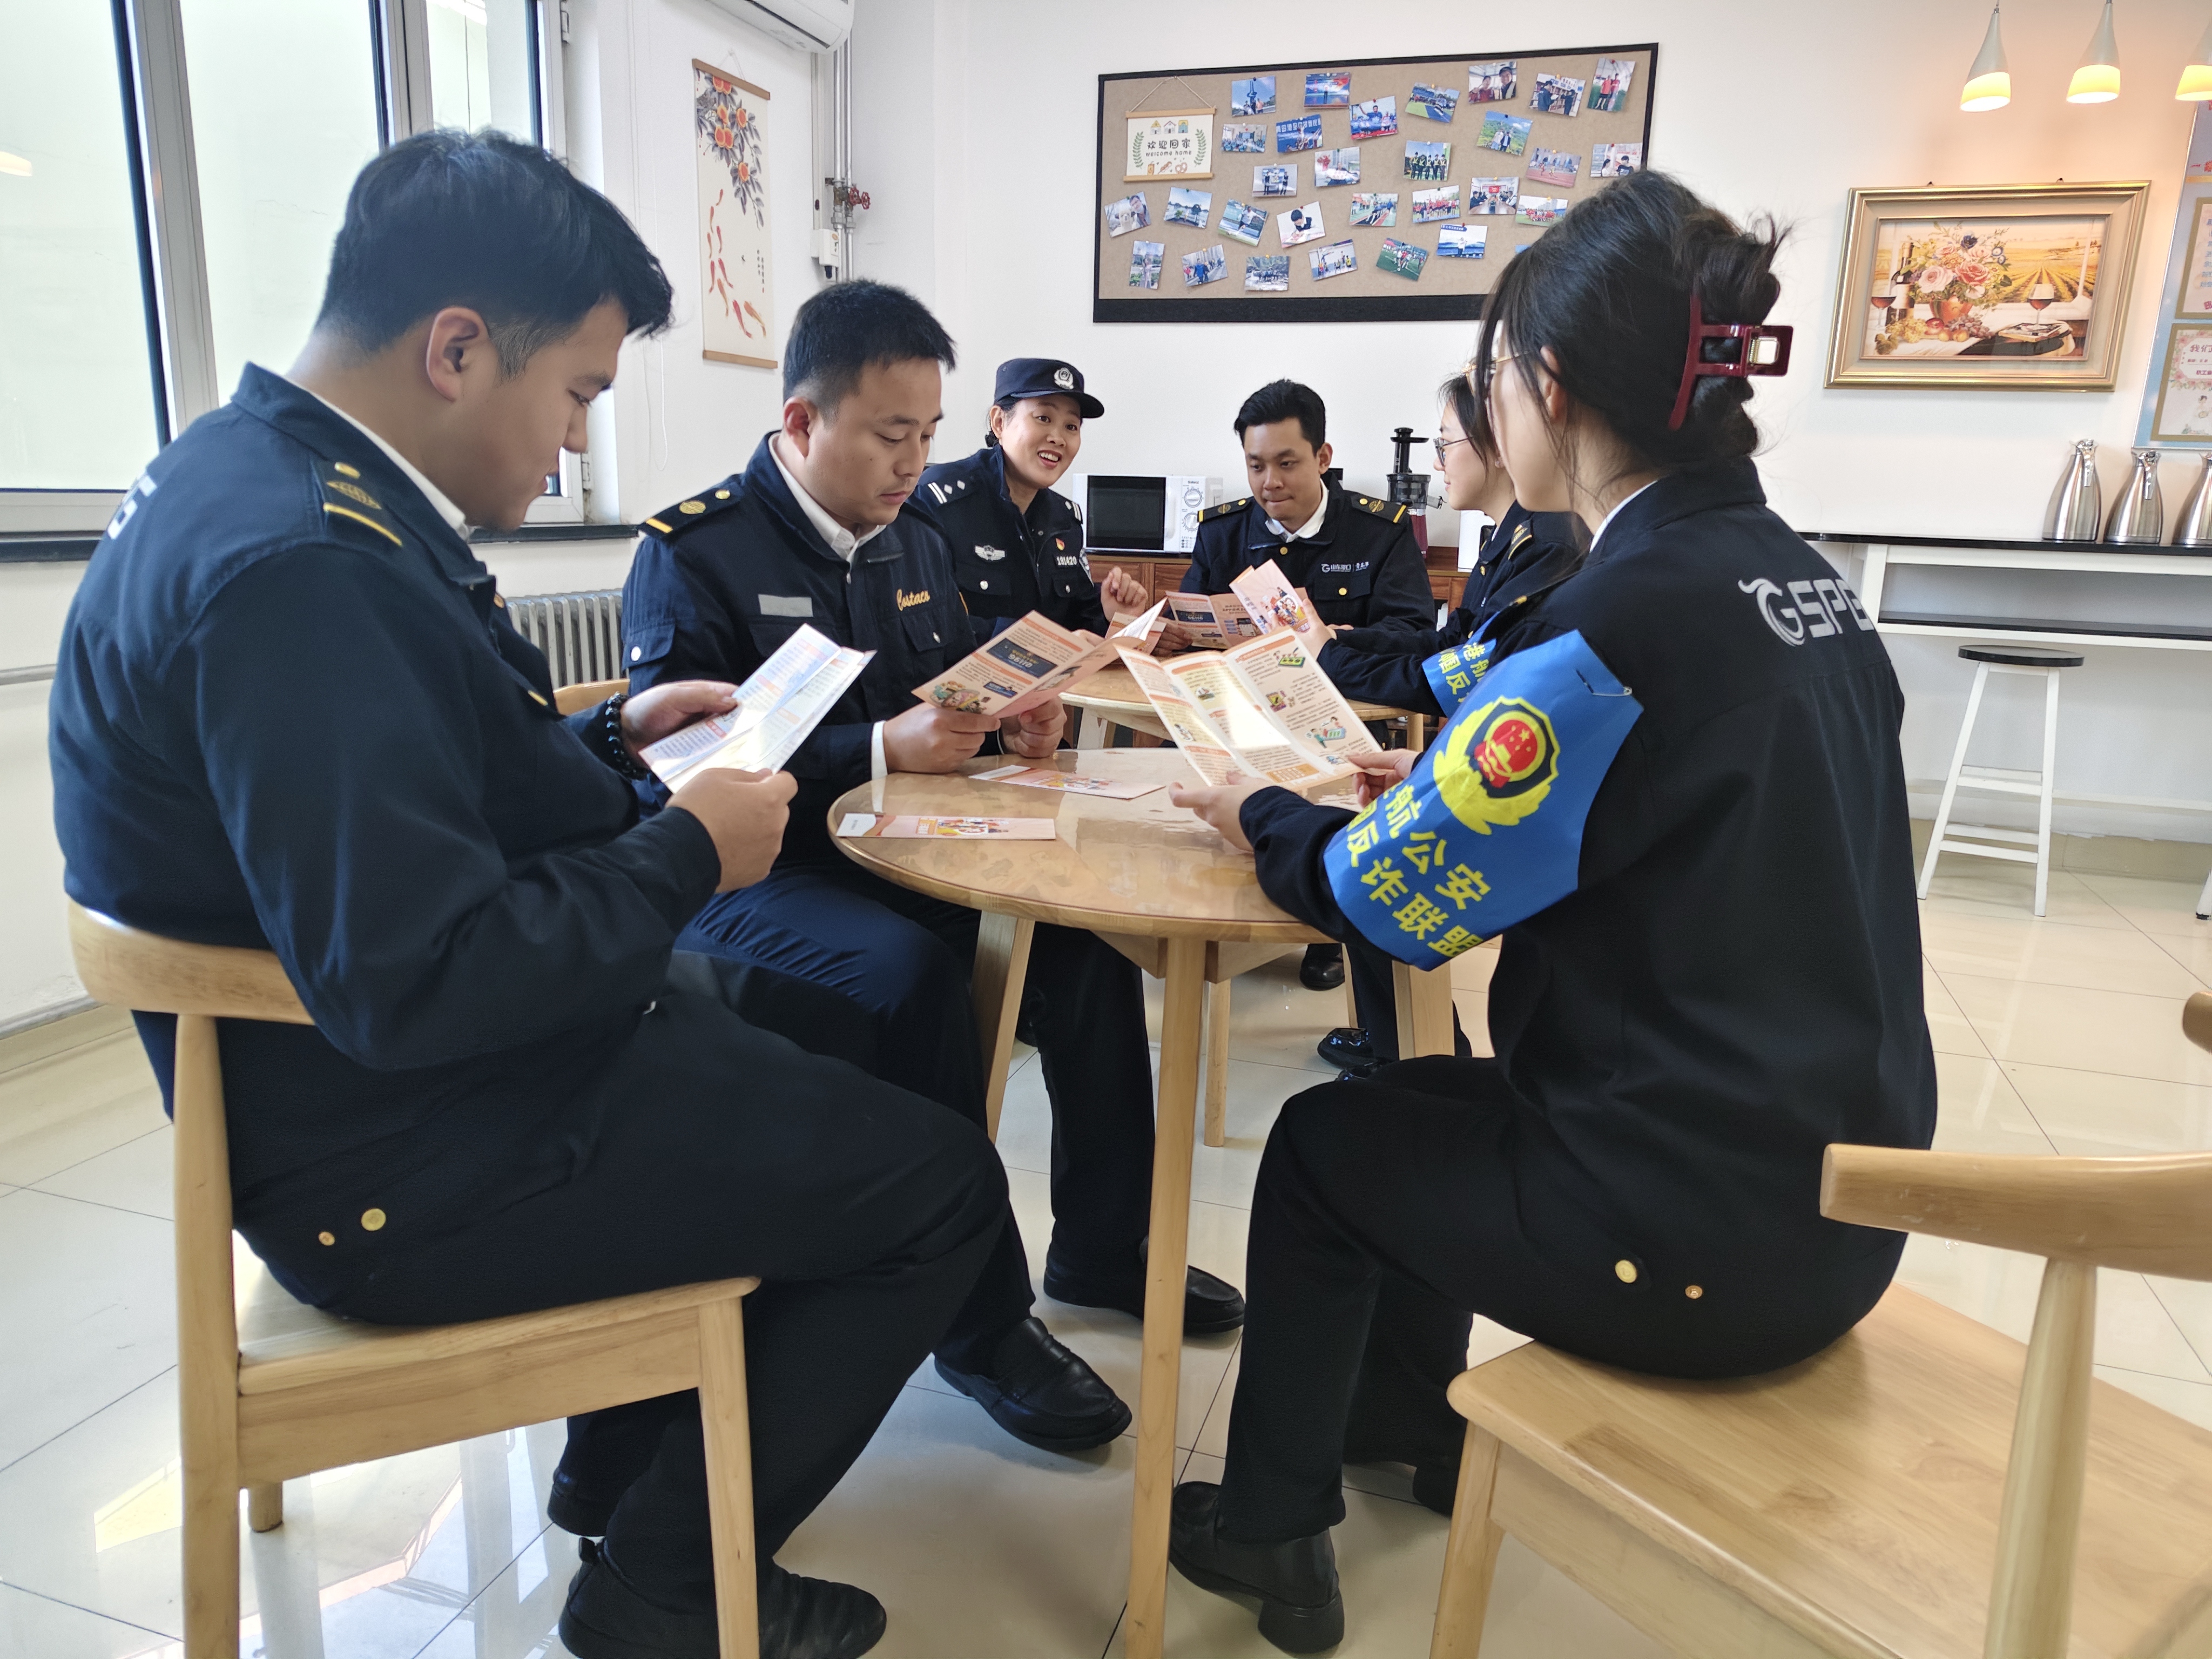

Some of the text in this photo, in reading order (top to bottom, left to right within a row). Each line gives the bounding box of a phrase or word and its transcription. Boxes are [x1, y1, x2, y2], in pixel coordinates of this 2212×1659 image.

[1147, 138, 1191, 150] 欢迎回家
[1056, 556, 1077, 566] 191420
[1383, 780, 1491, 910] 航公安
